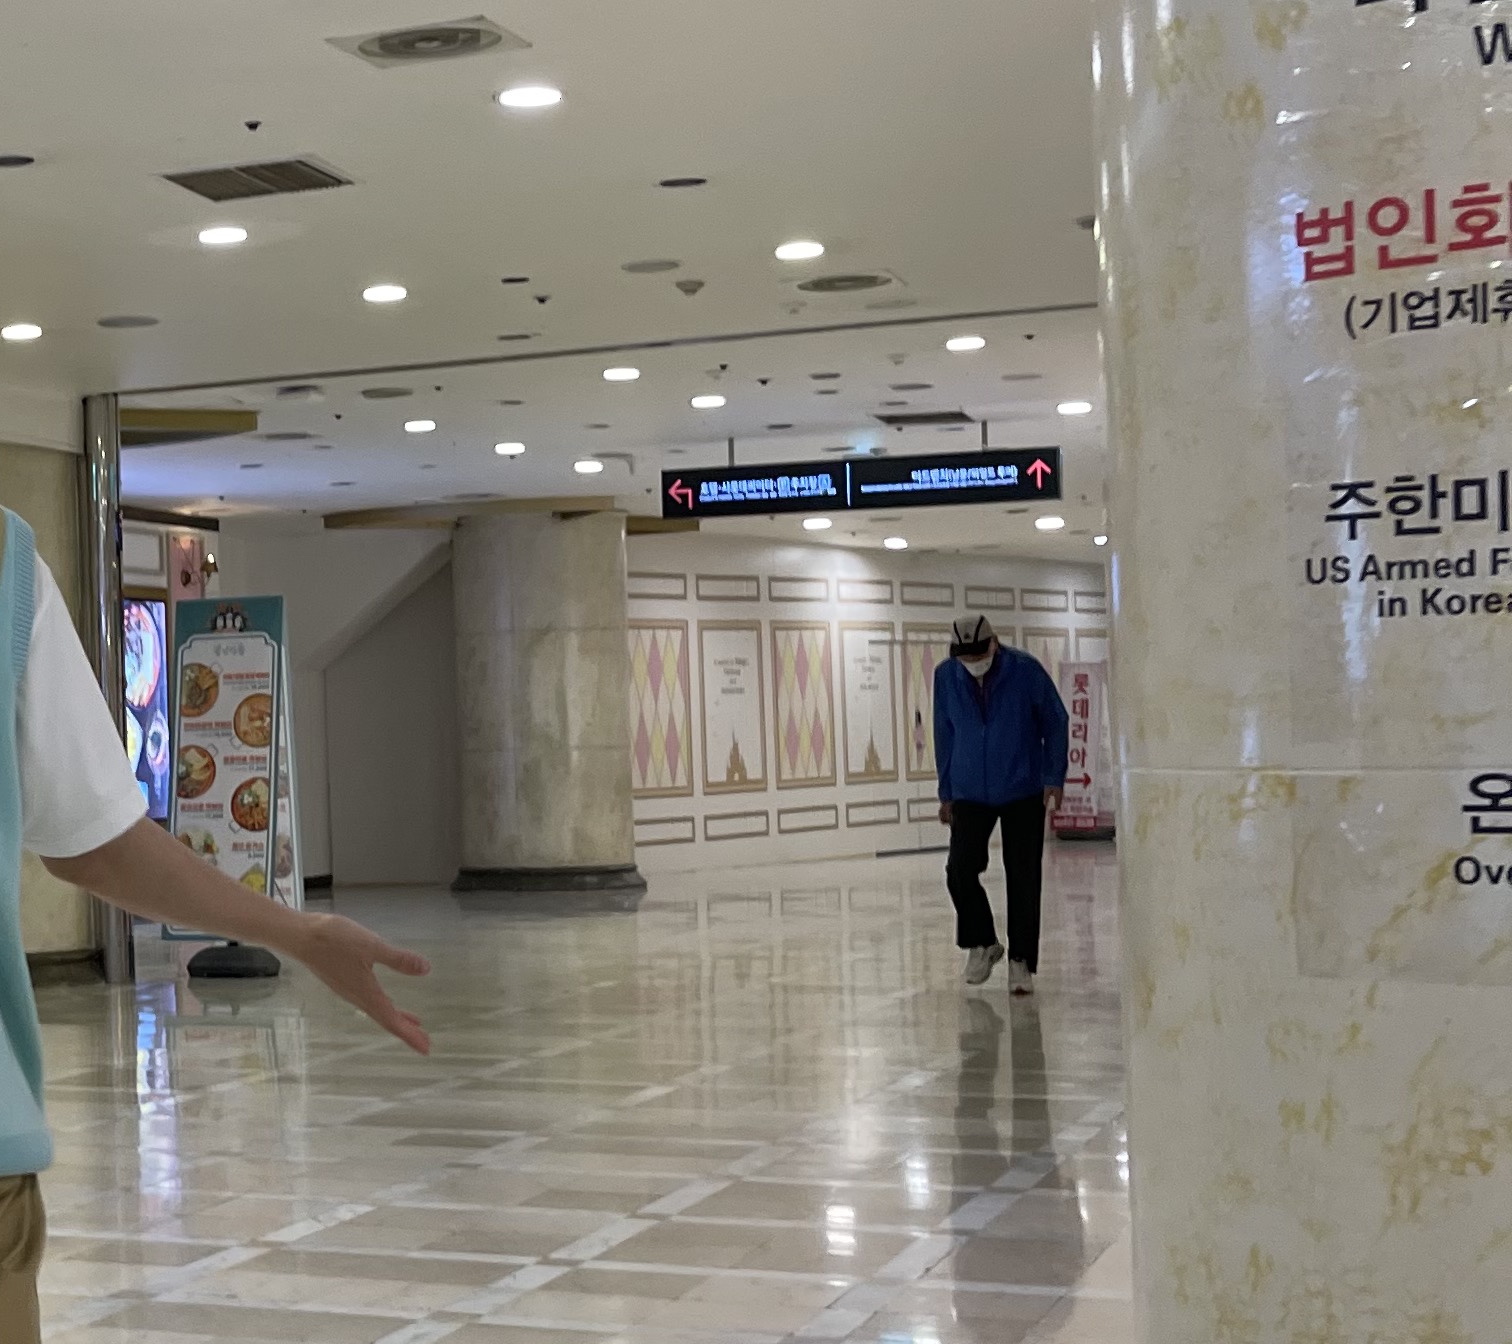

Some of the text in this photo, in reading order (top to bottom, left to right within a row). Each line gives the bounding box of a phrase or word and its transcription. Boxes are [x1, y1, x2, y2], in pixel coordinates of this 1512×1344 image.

[1324, 469, 1510, 541] 주한미
[1306, 547, 1512, 584] US Armed F
[1377, 590, 1408, 618] in
